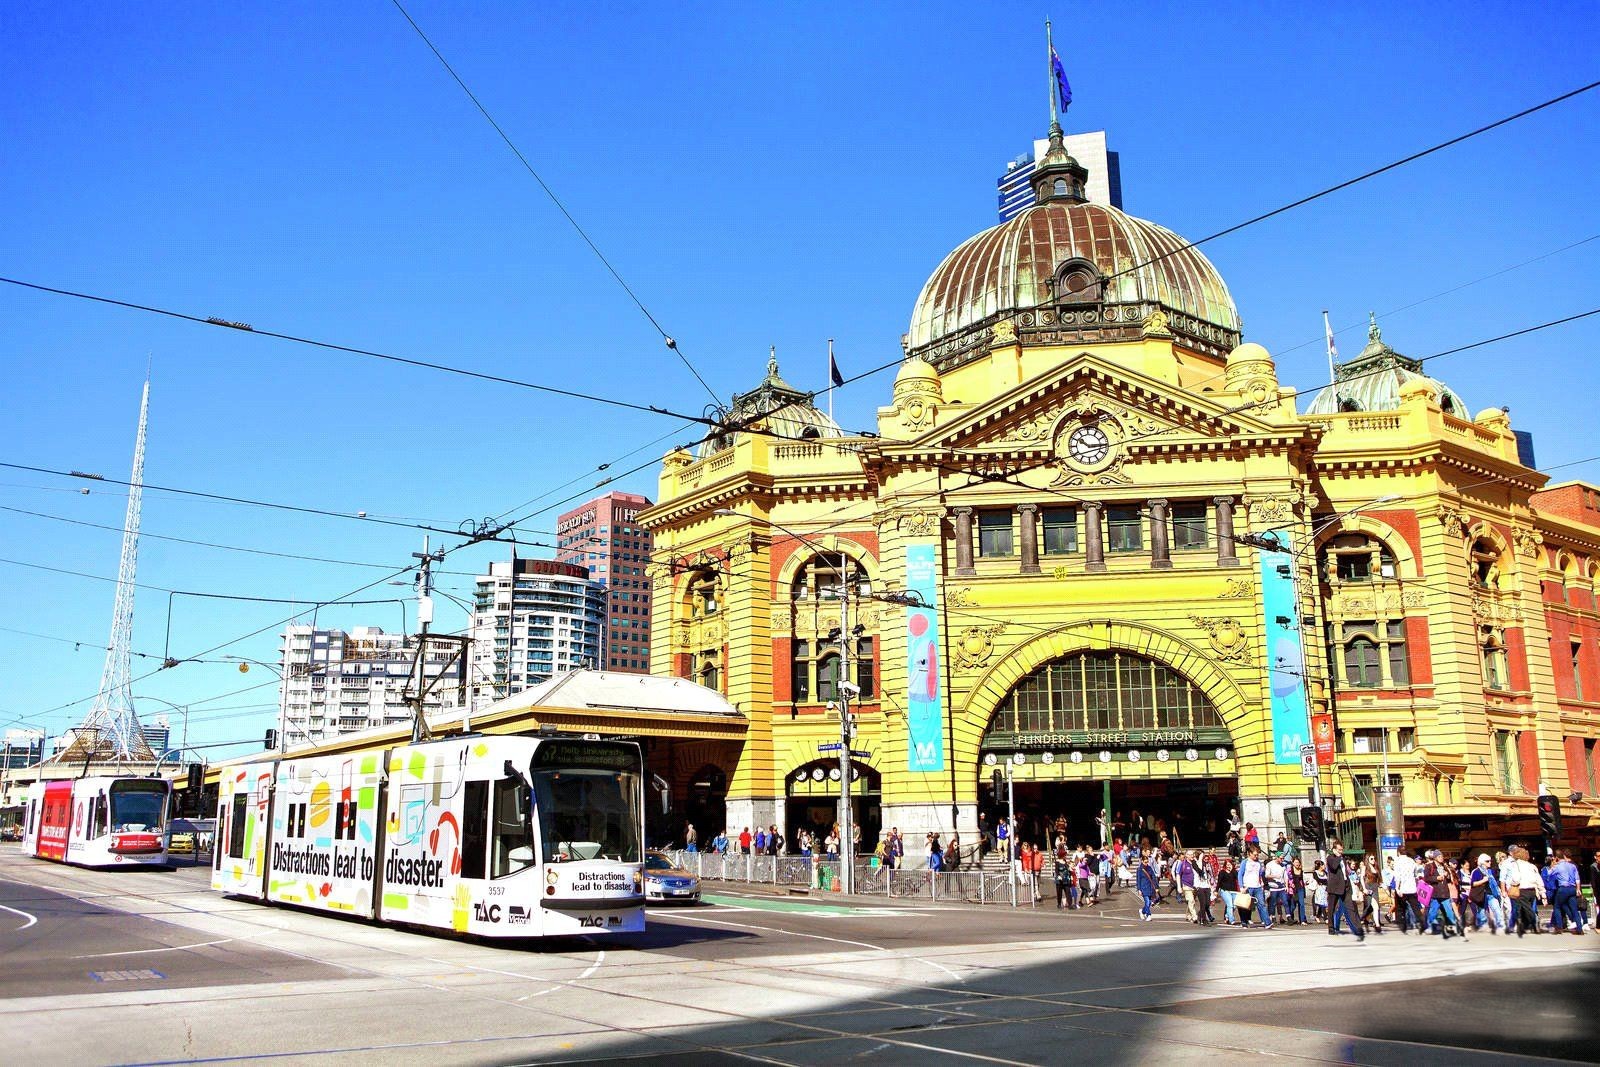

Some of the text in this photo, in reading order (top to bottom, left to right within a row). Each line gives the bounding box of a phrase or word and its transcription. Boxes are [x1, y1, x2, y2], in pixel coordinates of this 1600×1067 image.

[1018, 731, 1194, 745] FLINDERS STREET STATION
[273, 842, 444, 888] Distractions lead to disaster.
[578, 872, 626, 881] Distractions
[488, 886, 506, 896] 3537
[572, 882, 591, 891] lead
[593, 882, 602, 891] to
[473, 899, 502, 924] TAC
[578, 914, 604, 928] TAC
